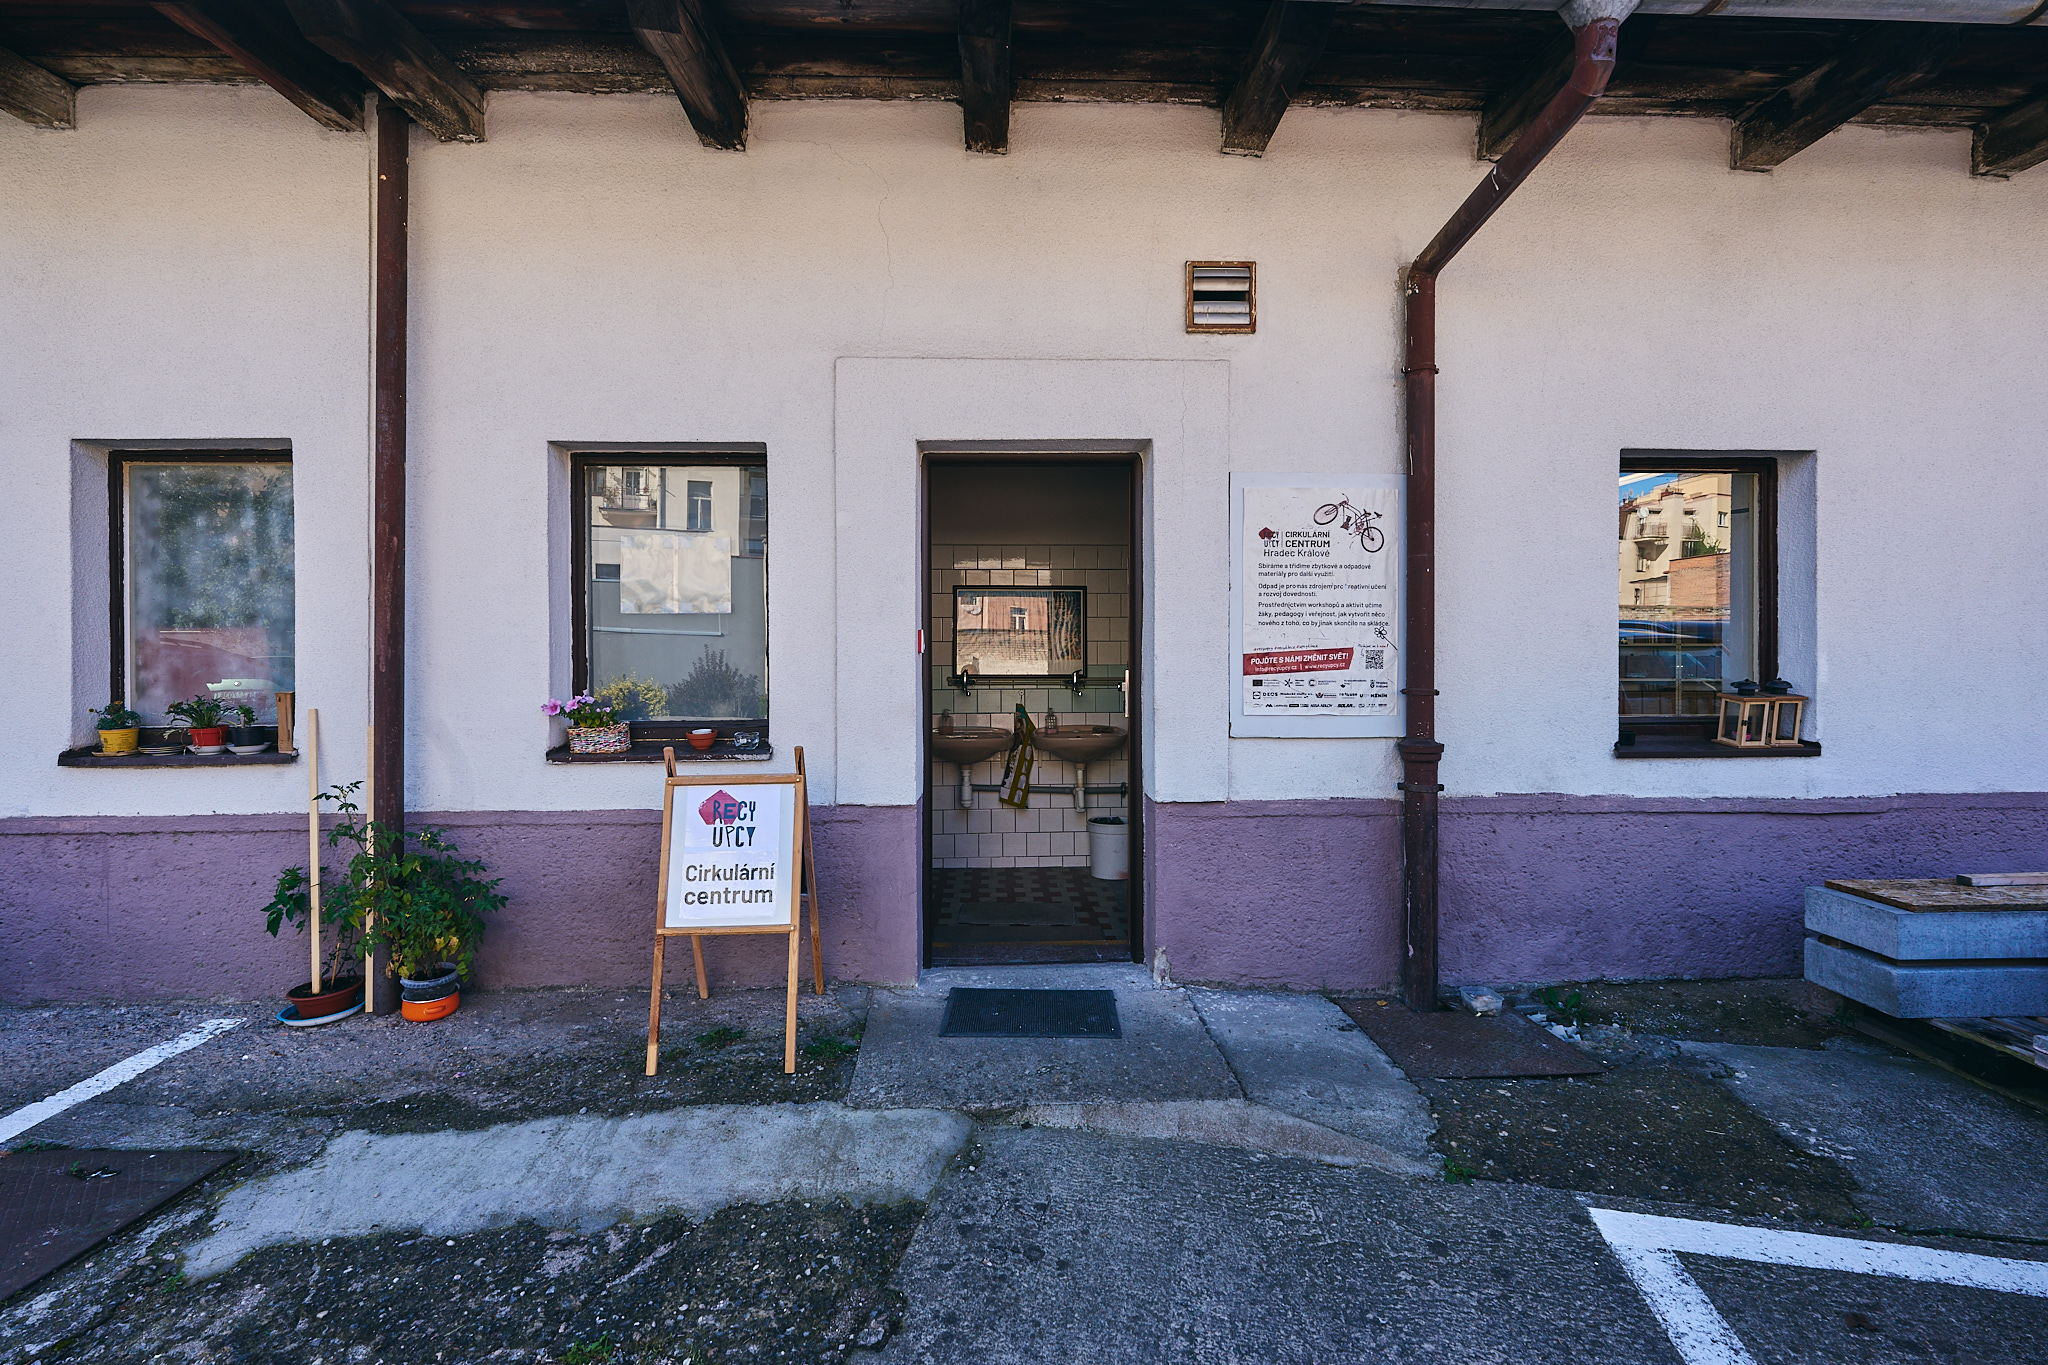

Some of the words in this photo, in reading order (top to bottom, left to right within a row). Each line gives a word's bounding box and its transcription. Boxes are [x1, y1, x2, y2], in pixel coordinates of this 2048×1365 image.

[1298, 549, 1330, 557] Králové
[1251, 656, 1278, 665] POJĎTE
[1303, 653, 1328, 661] ZMĚNIT
[1329, 652, 1349, 660] SVĚT!
[713, 800, 756, 824] RECY
[712, 826, 756, 847] UPCY
[685, 863, 775, 882] Cirkulární
[684, 888, 773, 905] centrum
